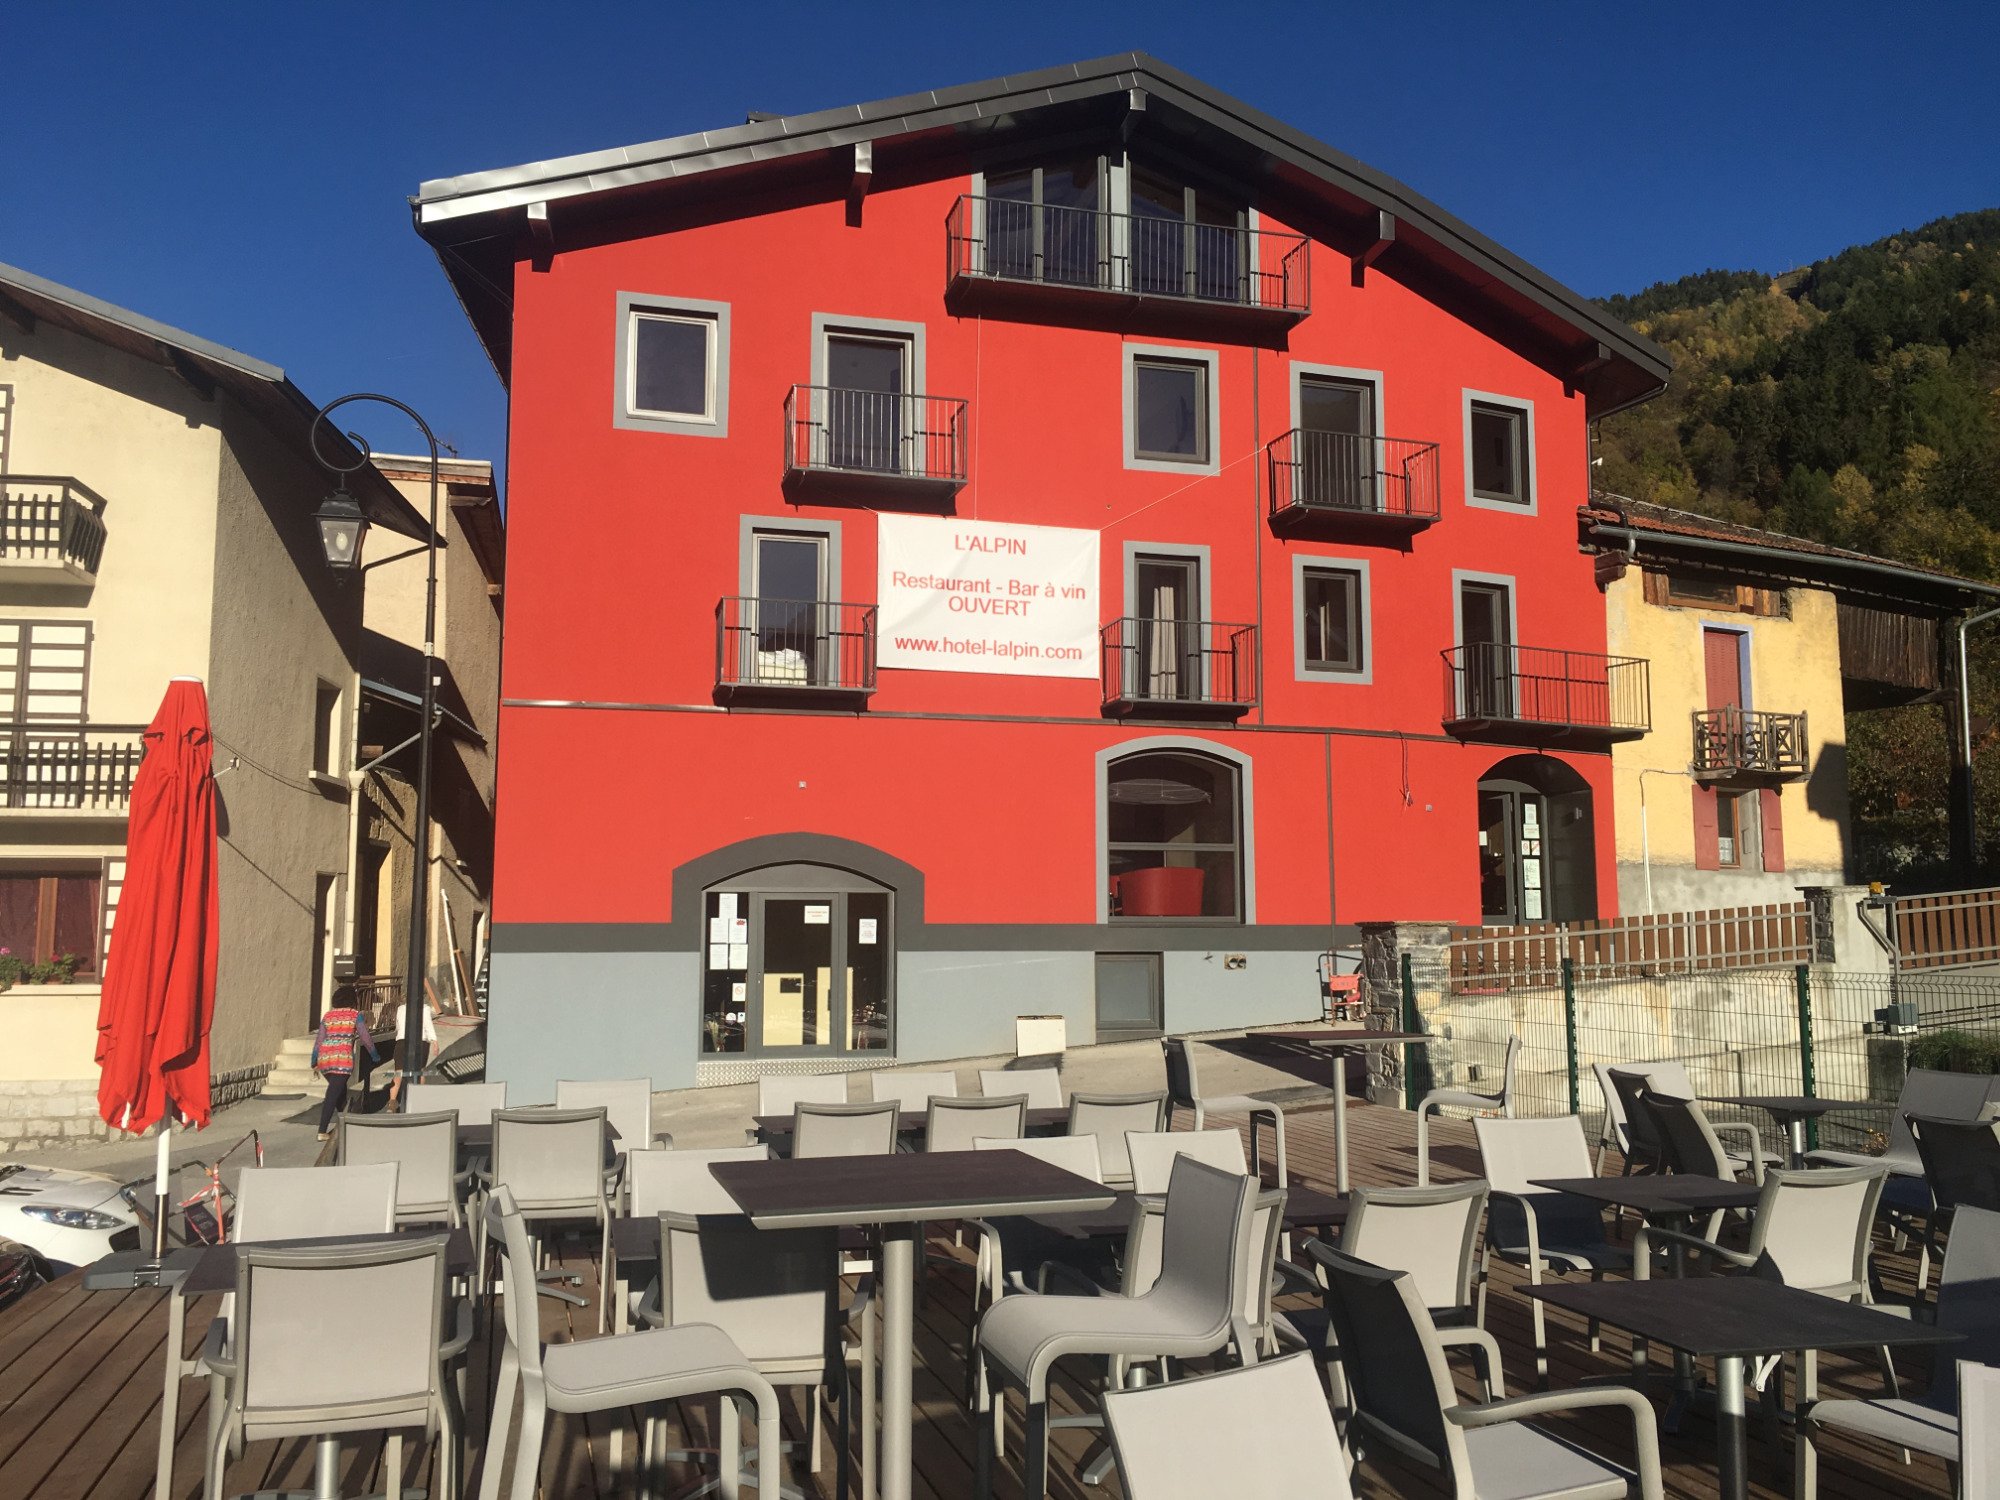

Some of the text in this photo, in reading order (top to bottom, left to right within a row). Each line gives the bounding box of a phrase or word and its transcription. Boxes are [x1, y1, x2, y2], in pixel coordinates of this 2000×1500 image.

[954, 534, 1026, 555] L'ALPIN
[892, 571, 990, 594] Restaurant
[1008, 579, 1039, 597] Bar
[1044, 582, 1055, 598] à
[1061, 584, 1086, 600] vin
[948, 596, 1031, 617] OUVERT
[895, 637, 1082, 661] www.hotel-lalpin.com
